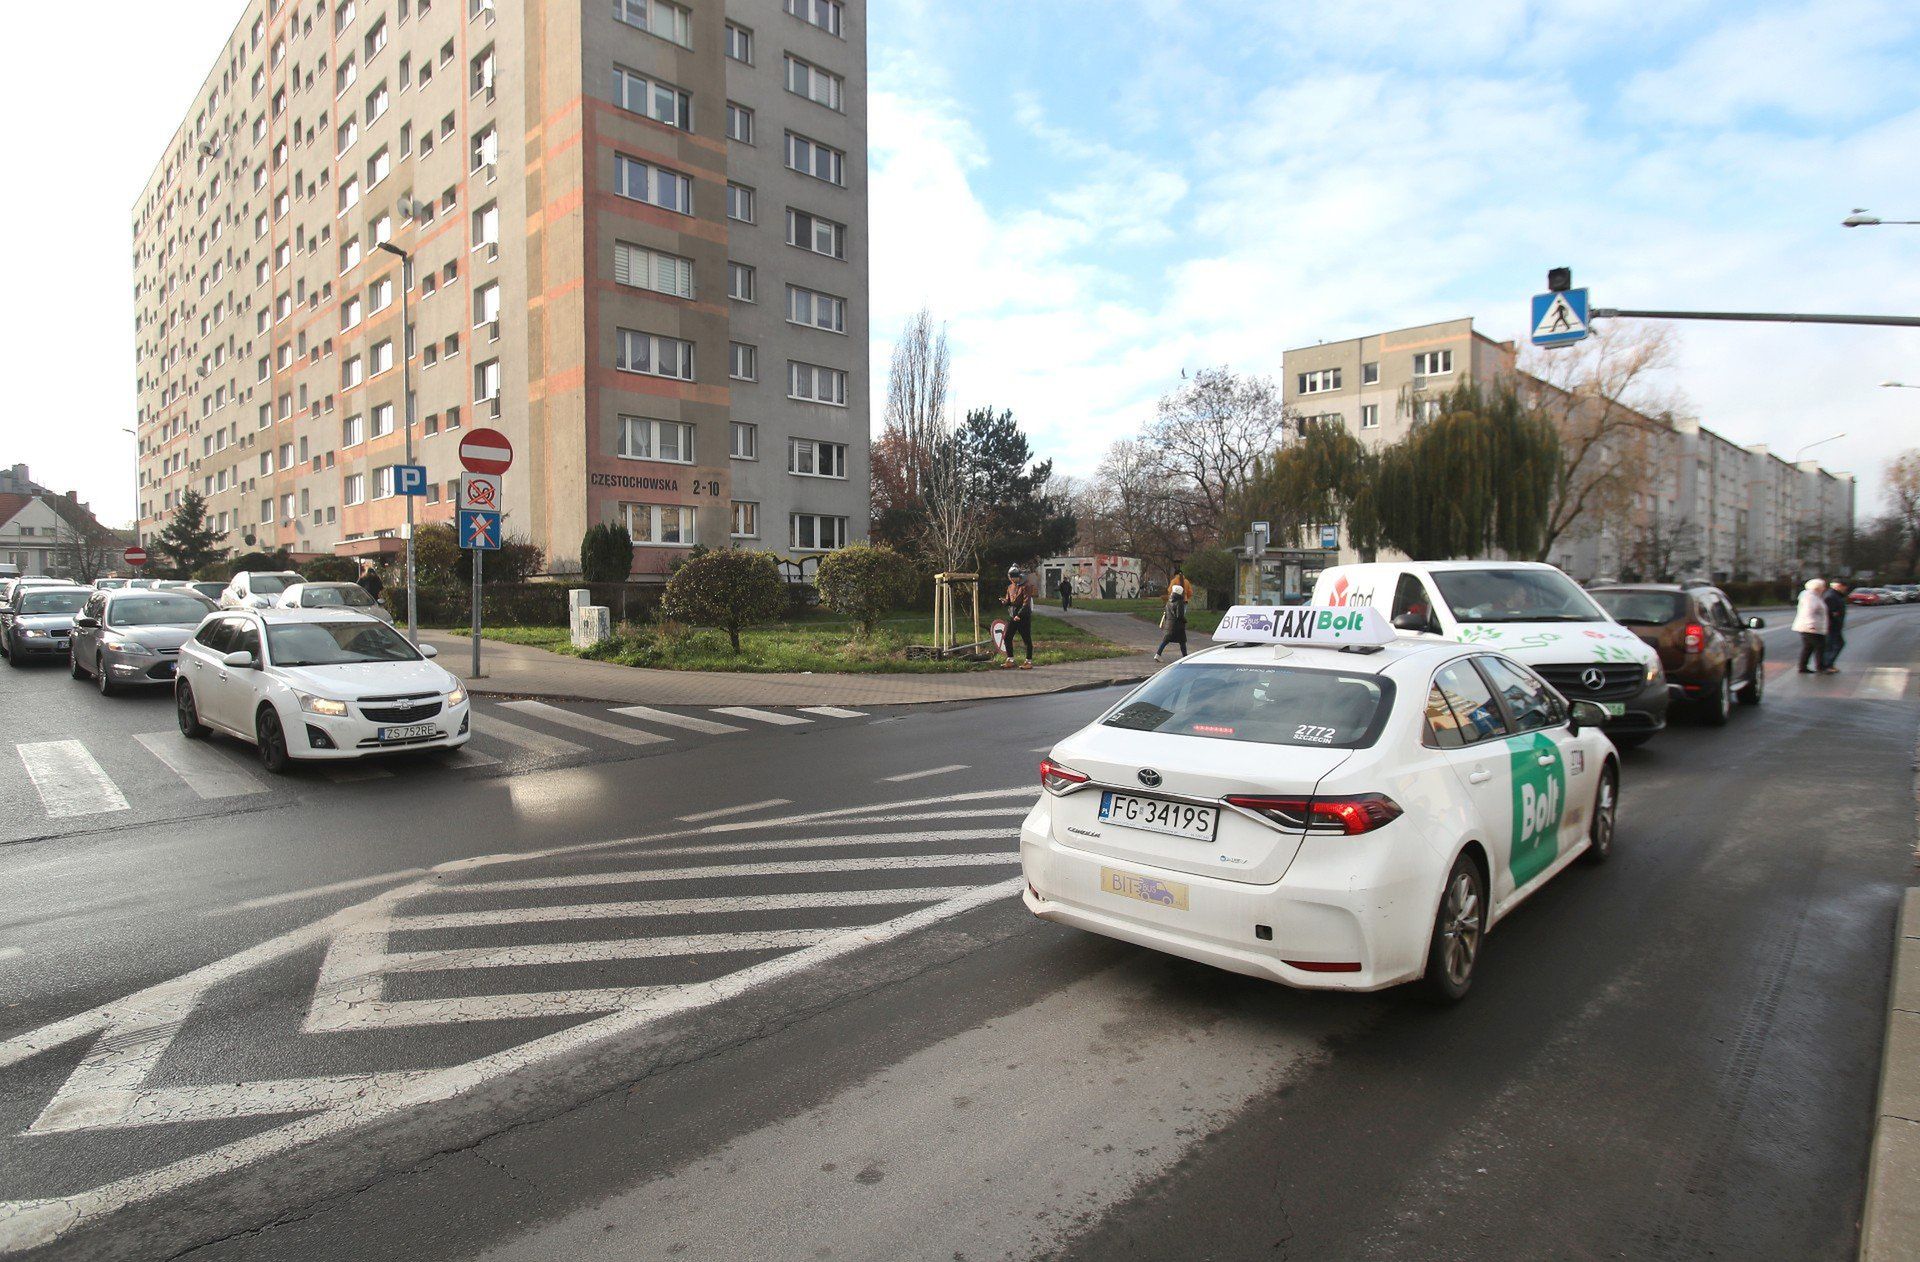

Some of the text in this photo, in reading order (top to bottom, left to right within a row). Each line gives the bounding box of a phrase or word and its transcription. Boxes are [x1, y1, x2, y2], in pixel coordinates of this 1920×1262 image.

[402, 468, 420, 492] P
[591, 473, 678, 491] CZĘSTOCHOWSKA
[1222, 616, 1246, 629] BIT
[1272, 610, 1316, 638] TAXI
[1317, 611, 1363, 637] Bolt
[387, 729, 400, 738] ZS
[1293, 734, 1332, 744] SZCZECIN
[1294, 724, 1336, 739] 2772
[1113, 797, 1210, 832] FG 3419S
[1521, 773, 1559, 848] Bolt
[1113, 874, 1157, 894] BIT BUS
